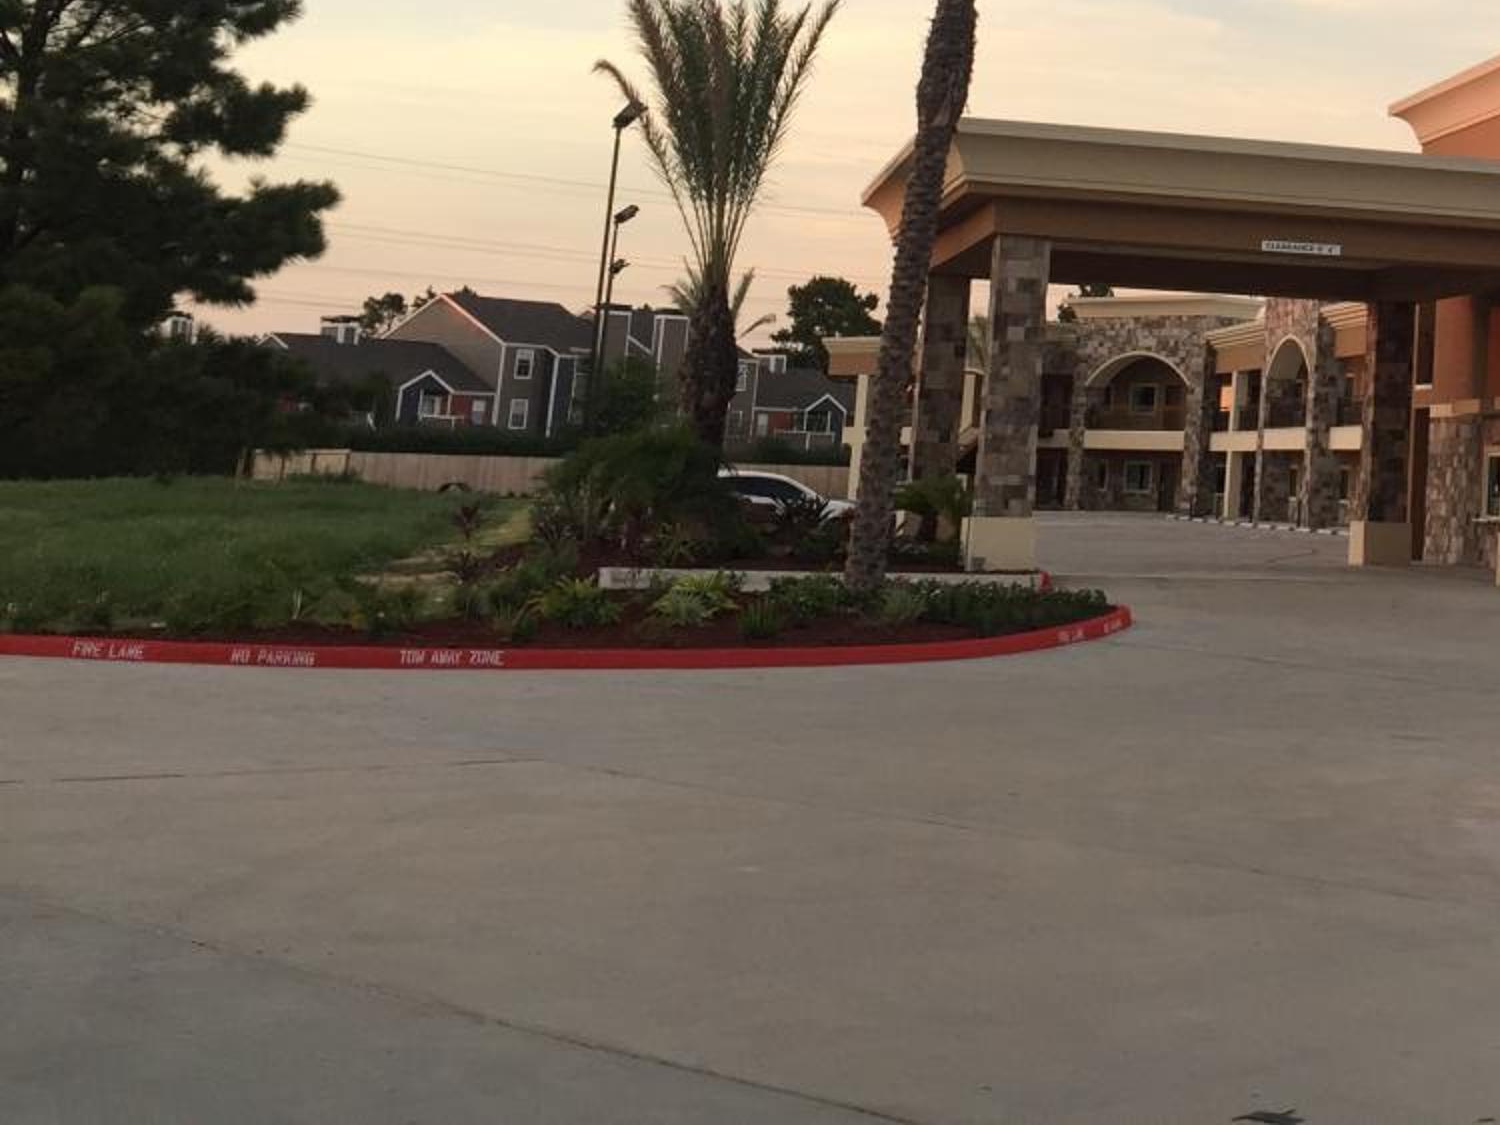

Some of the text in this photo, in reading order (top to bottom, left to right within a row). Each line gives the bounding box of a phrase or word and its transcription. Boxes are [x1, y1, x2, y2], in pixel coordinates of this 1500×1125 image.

[71, 640, 145, 660] FIRE LANE
[230, 648, 316, 667] NO PARKING
[400, 650, 505, 666] TOW AWAY ZONE
